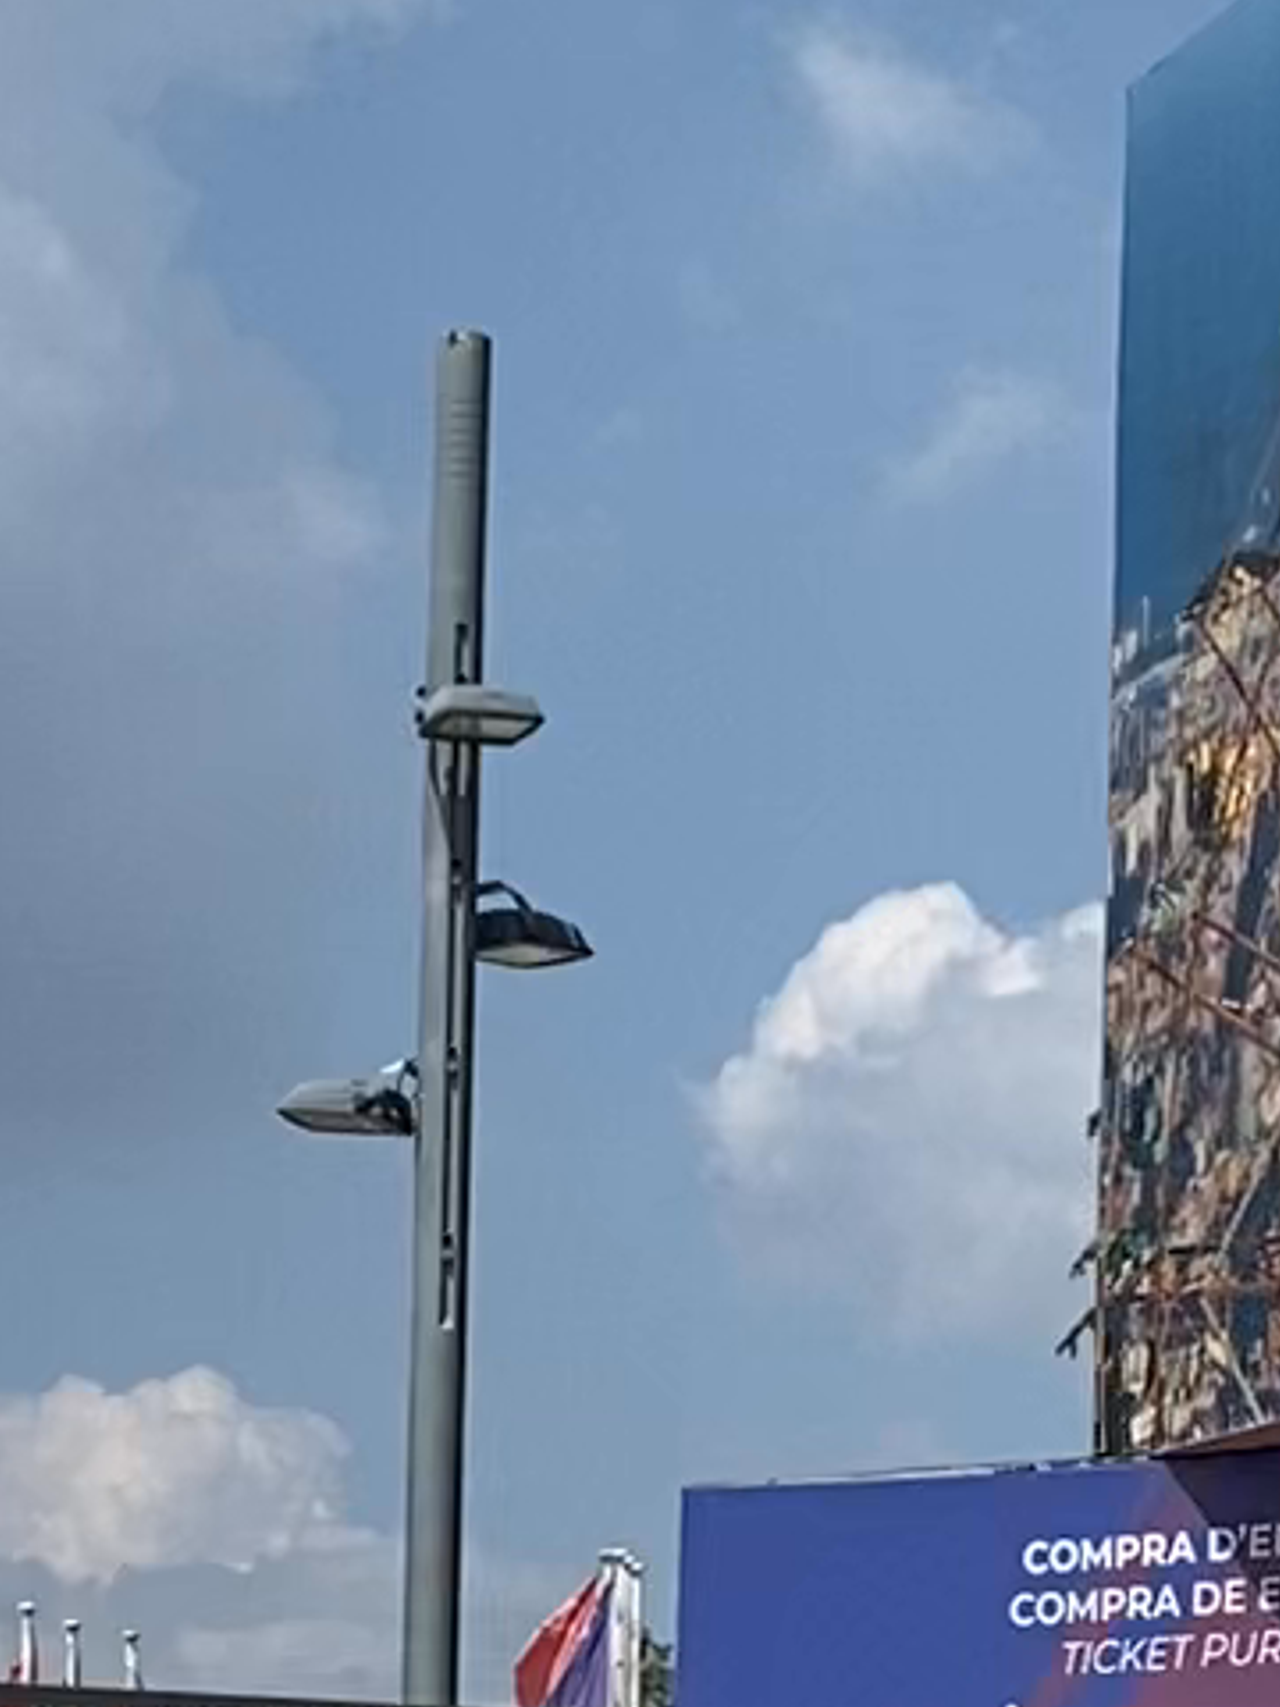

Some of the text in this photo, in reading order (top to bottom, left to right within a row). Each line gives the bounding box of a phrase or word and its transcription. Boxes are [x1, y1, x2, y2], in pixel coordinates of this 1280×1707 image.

[1023, 1530, 1197, 1576] COMPRA
[1010, 1586, 1182, 1627] COMPRA
[1193, 1579, 1247, 1615] DE
[1063, 1634, 1194, 1675] TICKET
